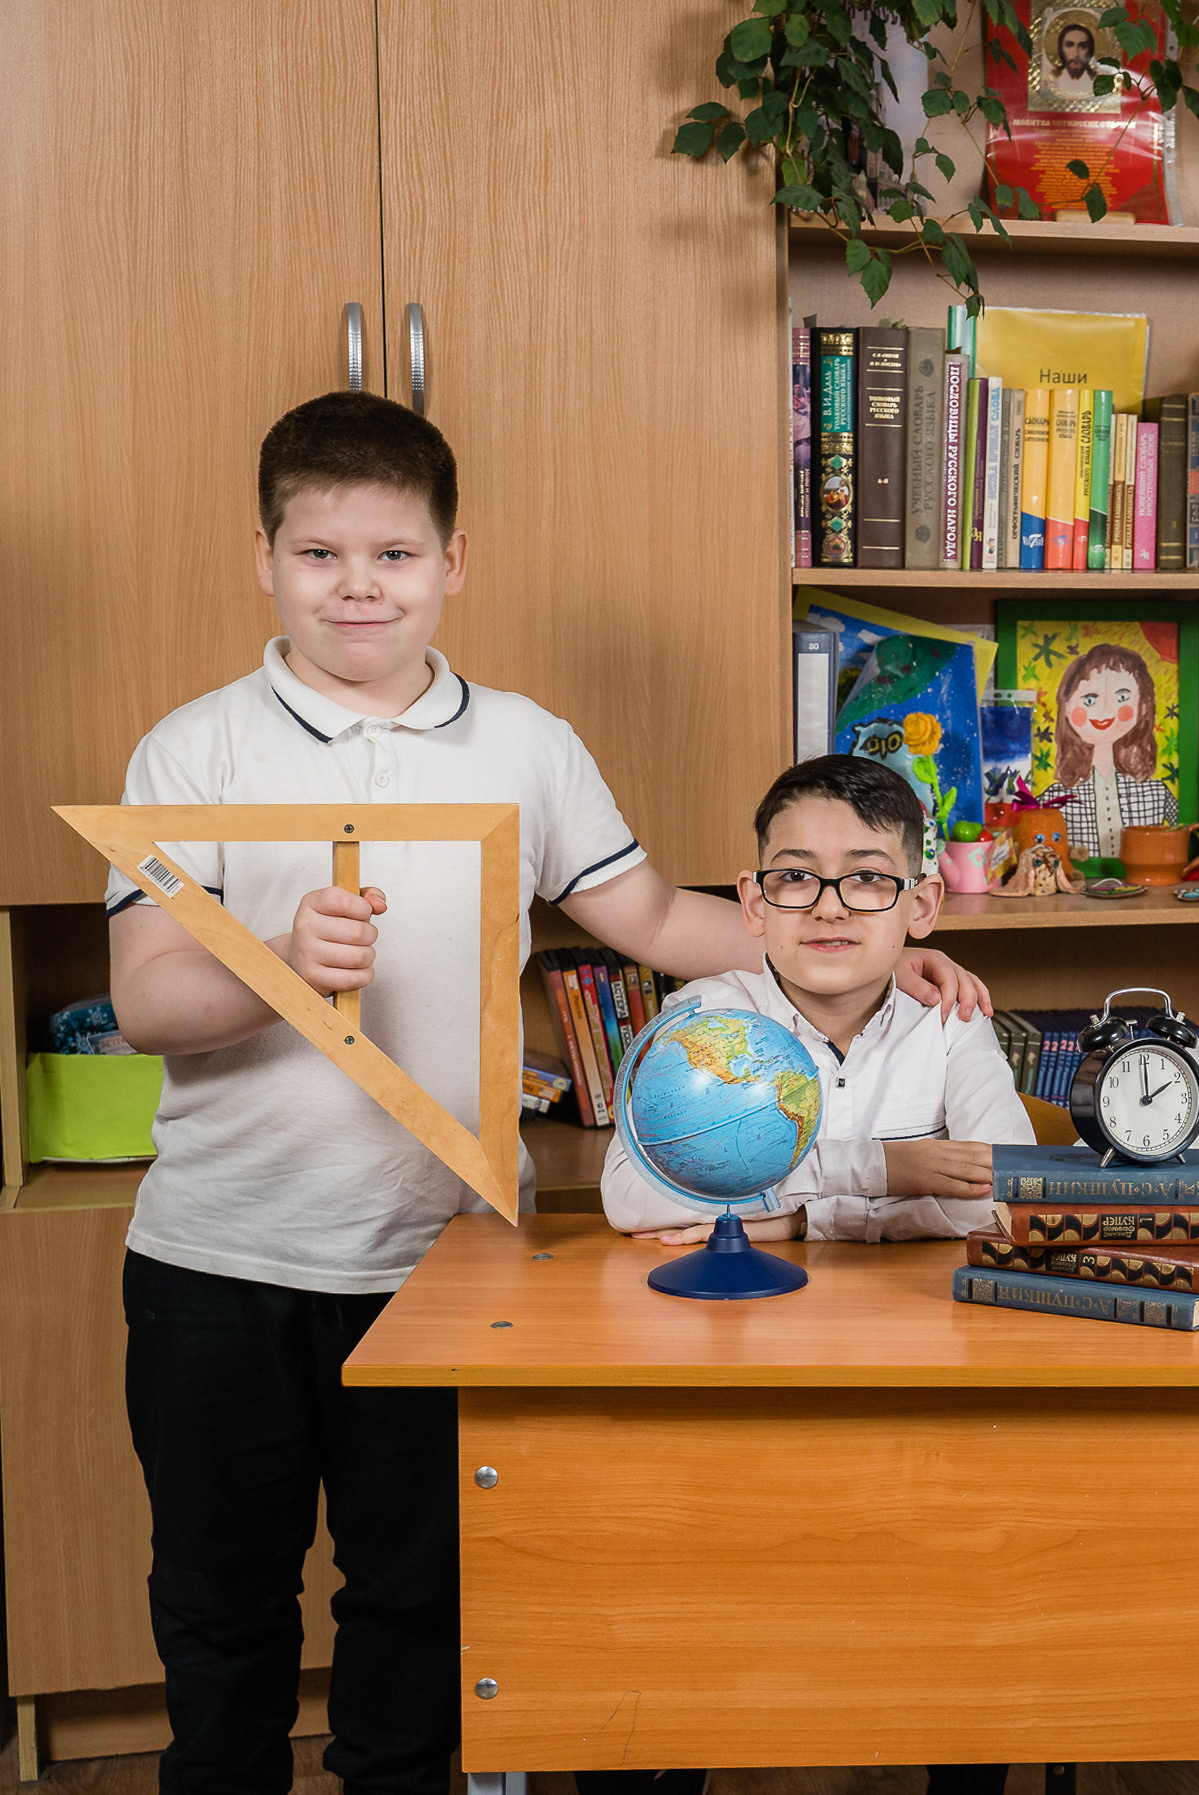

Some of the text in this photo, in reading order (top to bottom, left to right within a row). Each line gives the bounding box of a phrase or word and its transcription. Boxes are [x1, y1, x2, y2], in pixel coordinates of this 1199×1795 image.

[1039, 368, 1088, 385] Наши
[990, 387, 1001, 422] СЛОВА
[1080, 410, 1092, 444] СЛОВАРЬ
[911, 385, 924, 514] УЧЕБНЫЙ СЛОВАРЬ
[1139, 432, 1148, 469] СЛОВАРЬ
[1147, 433, 1155, 456] СЛОВ
[923, 391, 937, 511] РУССКОГО ЯЗЫКА
[946, 366, 960, 558] ПОСЛОВИЦЫ РУССКОГО НАРОДА
[1011, 428, 1021, 540] ОРФОГРАФИЧЕСКИЙ СЛОВАРЬ
[1044, 1041, 1051, 1051] 2
[1051, 1041, 1059, 1051] 2
[1060, 1040, 1067, 1050] 2
[1067, 1041, 1075, 1051] 2
[1139, 1053, 1150, 1066] 12
[1160, 1058, 1166, 1070] 1
[1121, 1061, 1131, 1073] 11
[1109, 1076, 1119, 1089] 10
[1173, 1072, 1181, 1084] 2
[1102, 1096, 1110, 1108] 9
[1180, 1093, 1188, 1105] 3
[1109, 1116, 1117, 1128] 8
[1174, 1112, 1182, 1124] 4
[1124, 1129, 1132, 1142] 7
[1142, 1134, 1150, 1147] 6
[1162, 1128, 1170, 1141] 5
[1101, 1215, 1136, 1226] КУПЕР
[1050, 1252, 1078, 1264] КУПЕР
[1082, 1254, 1096, 1265] 3
